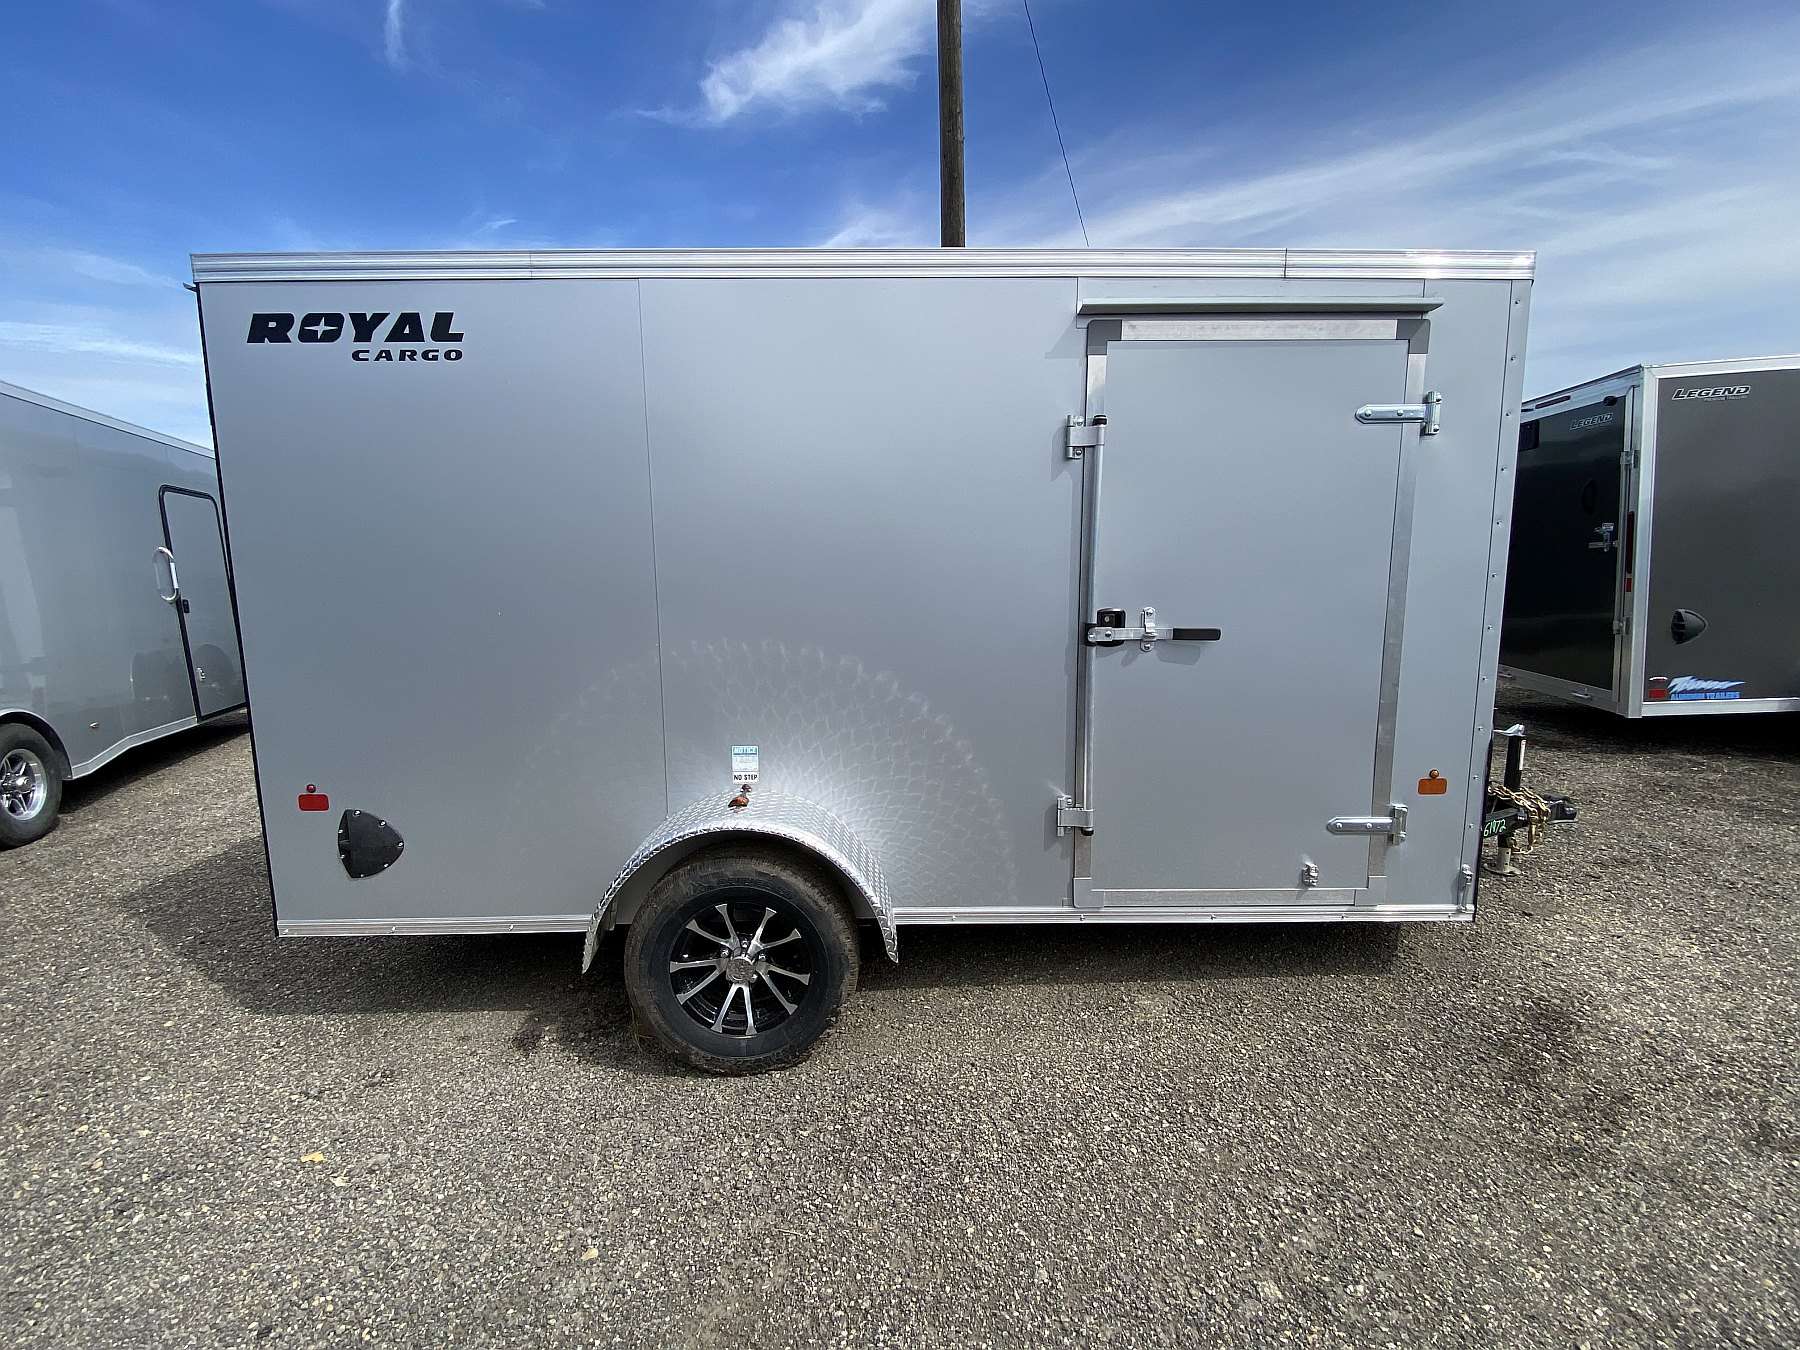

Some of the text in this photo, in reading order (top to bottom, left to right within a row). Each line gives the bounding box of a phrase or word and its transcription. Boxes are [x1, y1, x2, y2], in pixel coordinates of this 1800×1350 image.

[246, 312, 465, 343] ROYAL
[351, 349, 463, 362] CARGO
[1672, 385, 1751, 400] LEGEND
[1569, 412, 1614, 430] LEGEND
